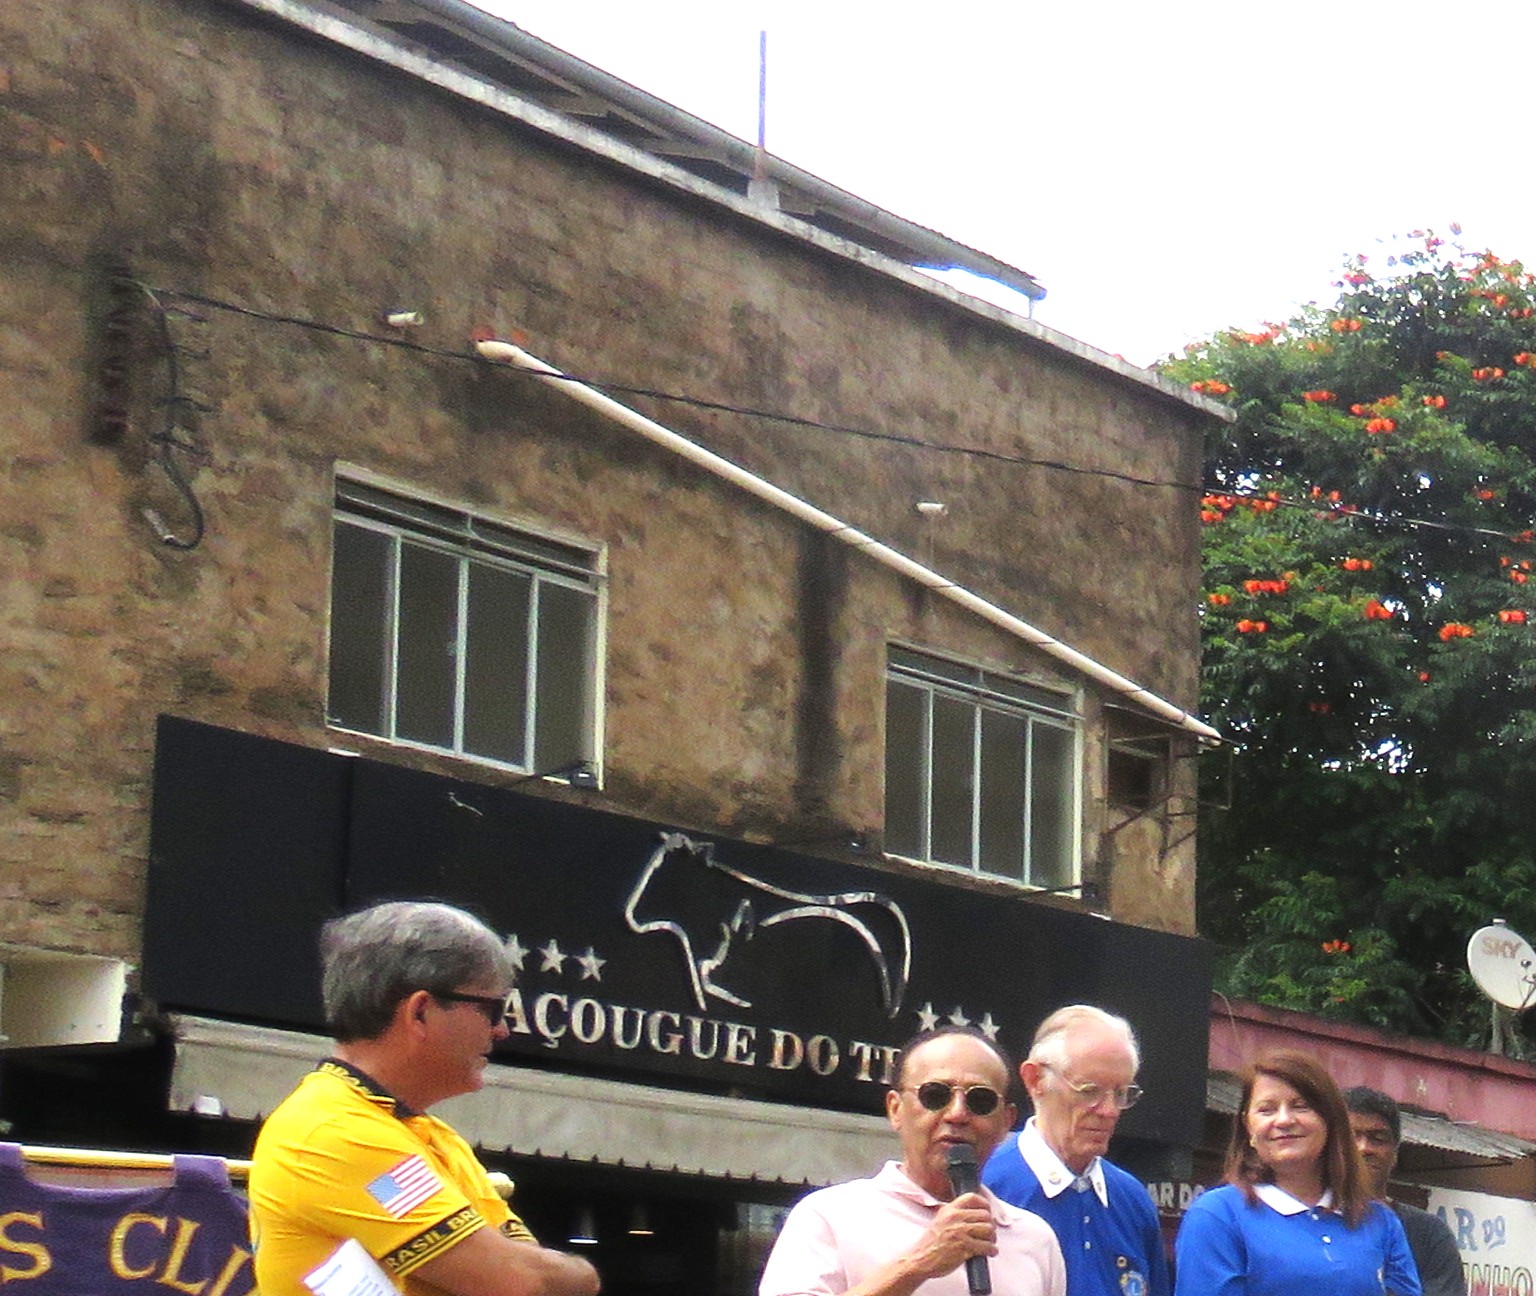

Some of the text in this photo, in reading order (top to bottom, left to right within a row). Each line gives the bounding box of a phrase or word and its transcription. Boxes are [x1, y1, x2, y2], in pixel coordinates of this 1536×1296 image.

[501, 987, 757, 1066] AÇOUGUE
[766, 1028, 840, 1077] DO
[1147, 1182, 1174, 1208] AR
